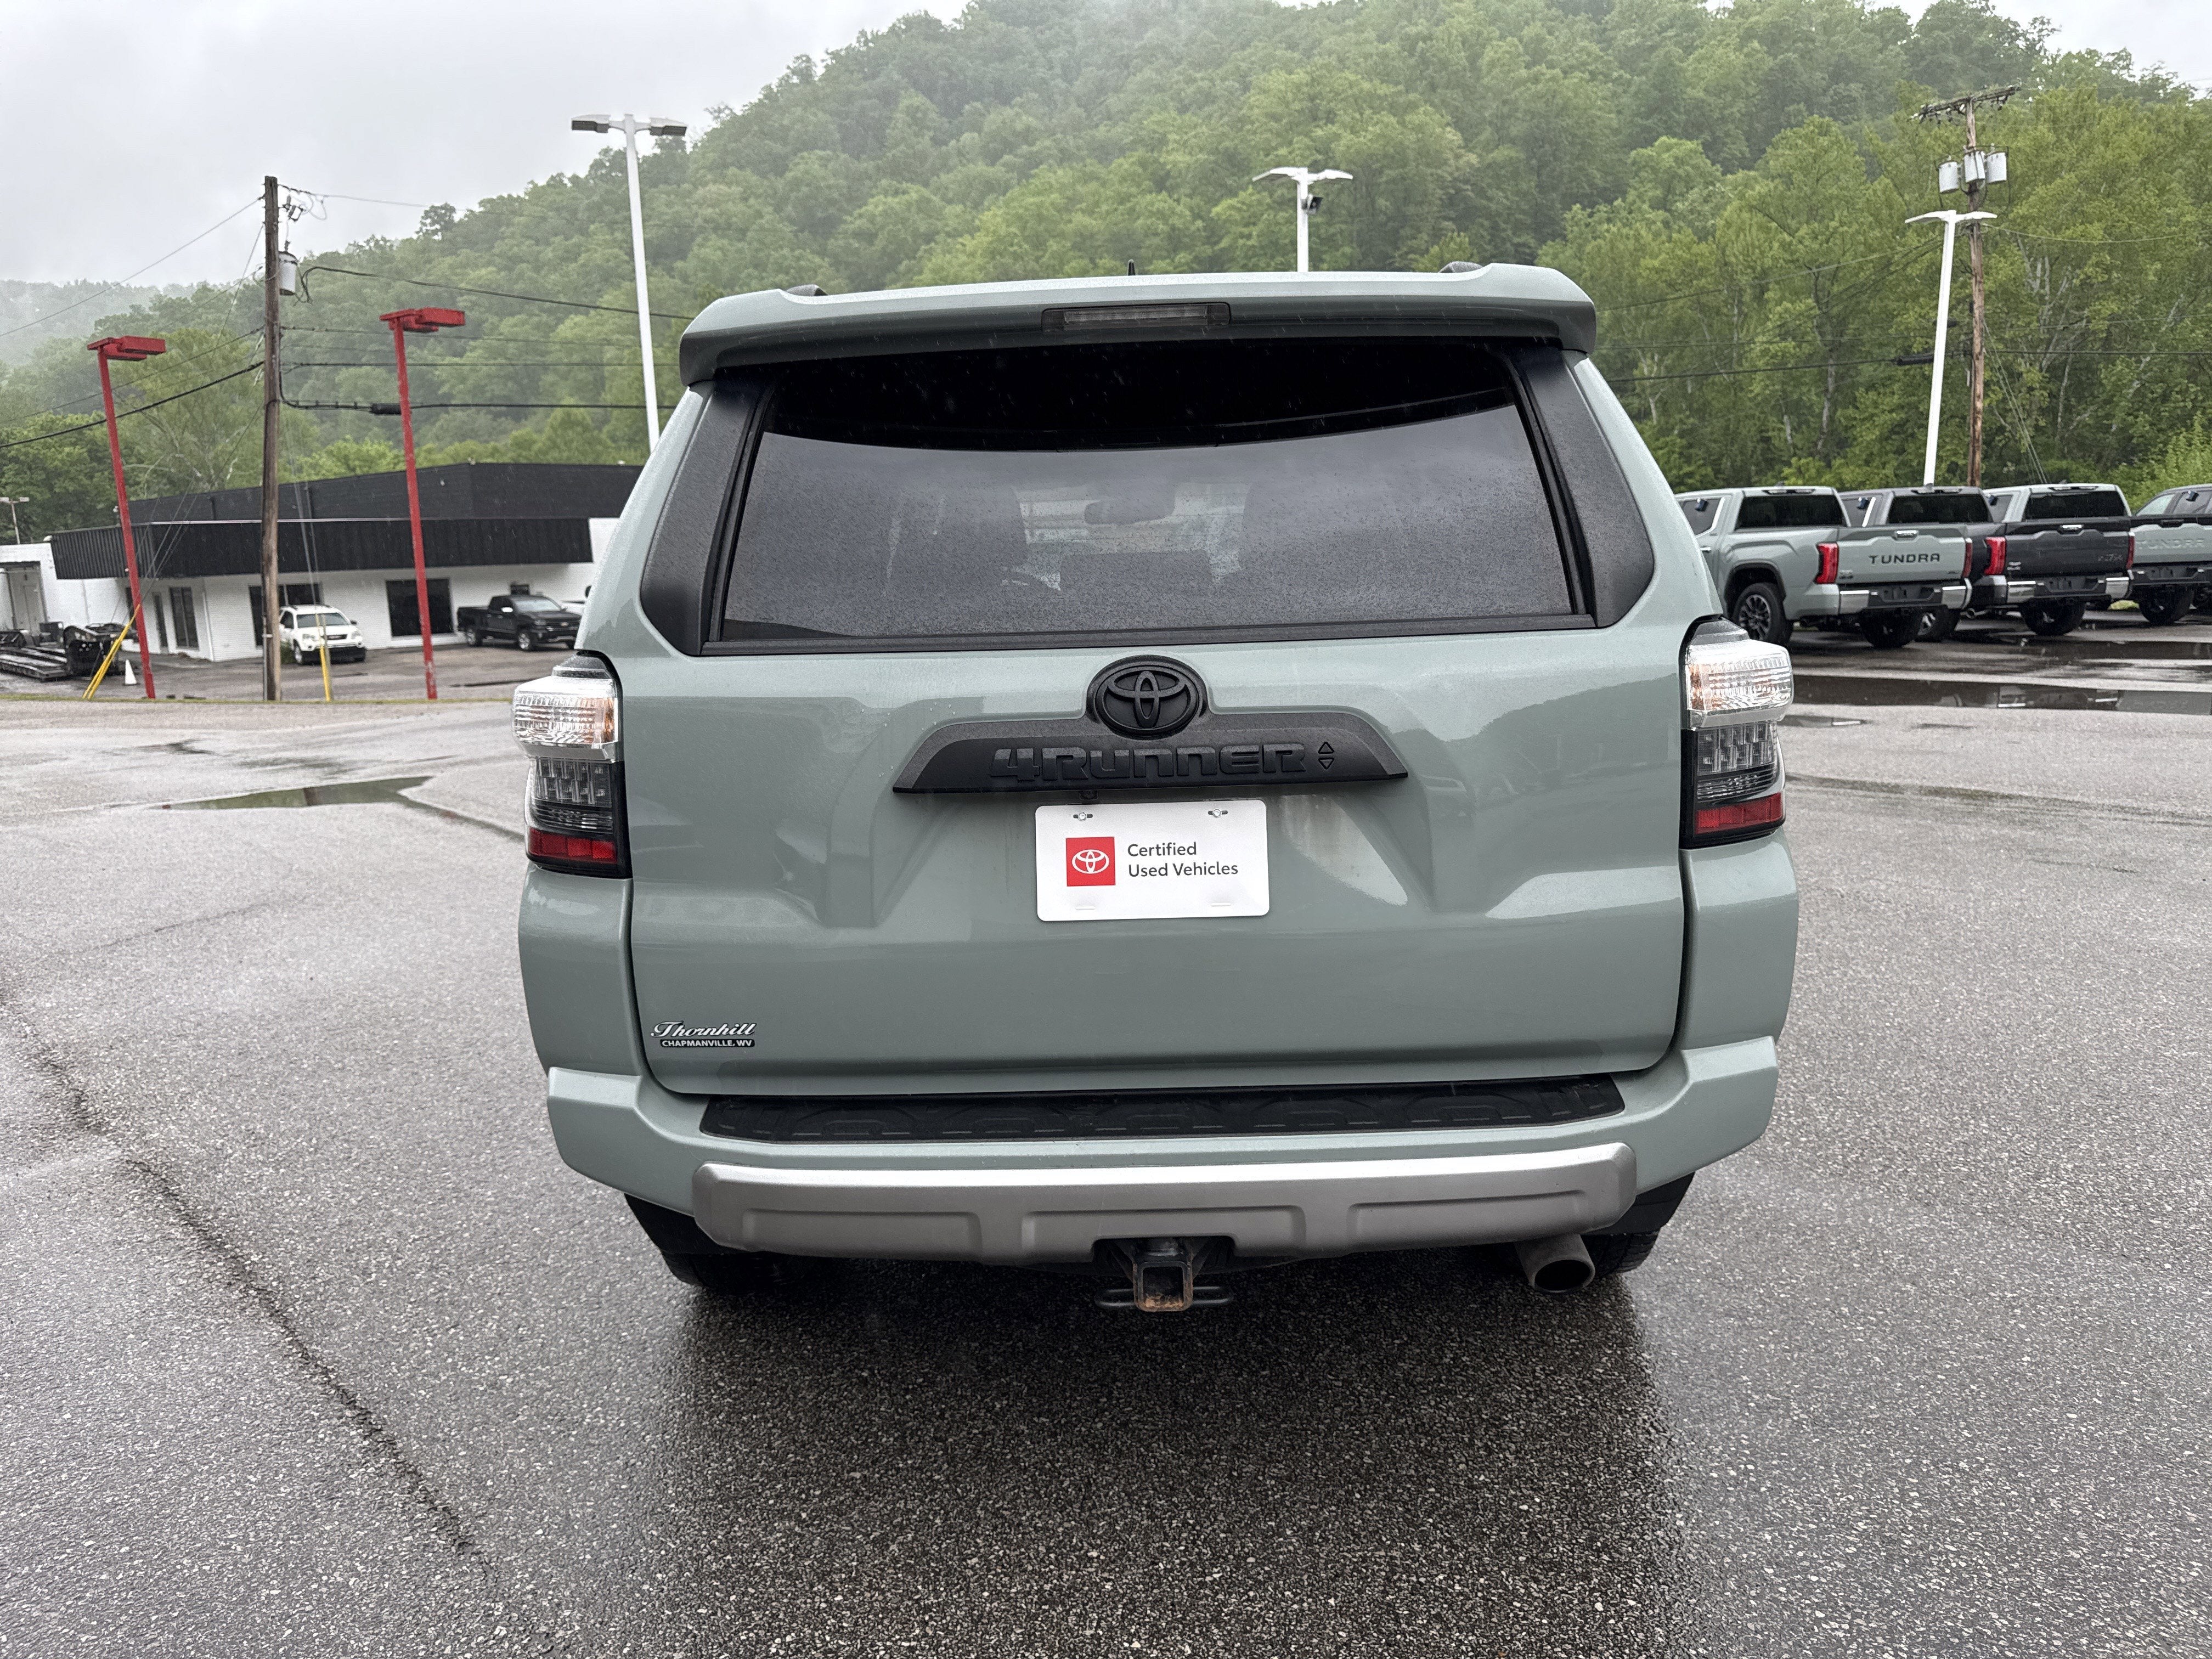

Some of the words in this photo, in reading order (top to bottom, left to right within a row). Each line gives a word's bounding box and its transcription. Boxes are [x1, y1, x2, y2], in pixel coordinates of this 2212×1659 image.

[1869, 553, 1940, 565] TUNDRA
[1127, 842, 1197, 856] Certified
[1128, 863, 1168, 877] Used
[1172, 861, 1238, 876] Vehicles
[651, 1020, 757, 1037] Thornhill
